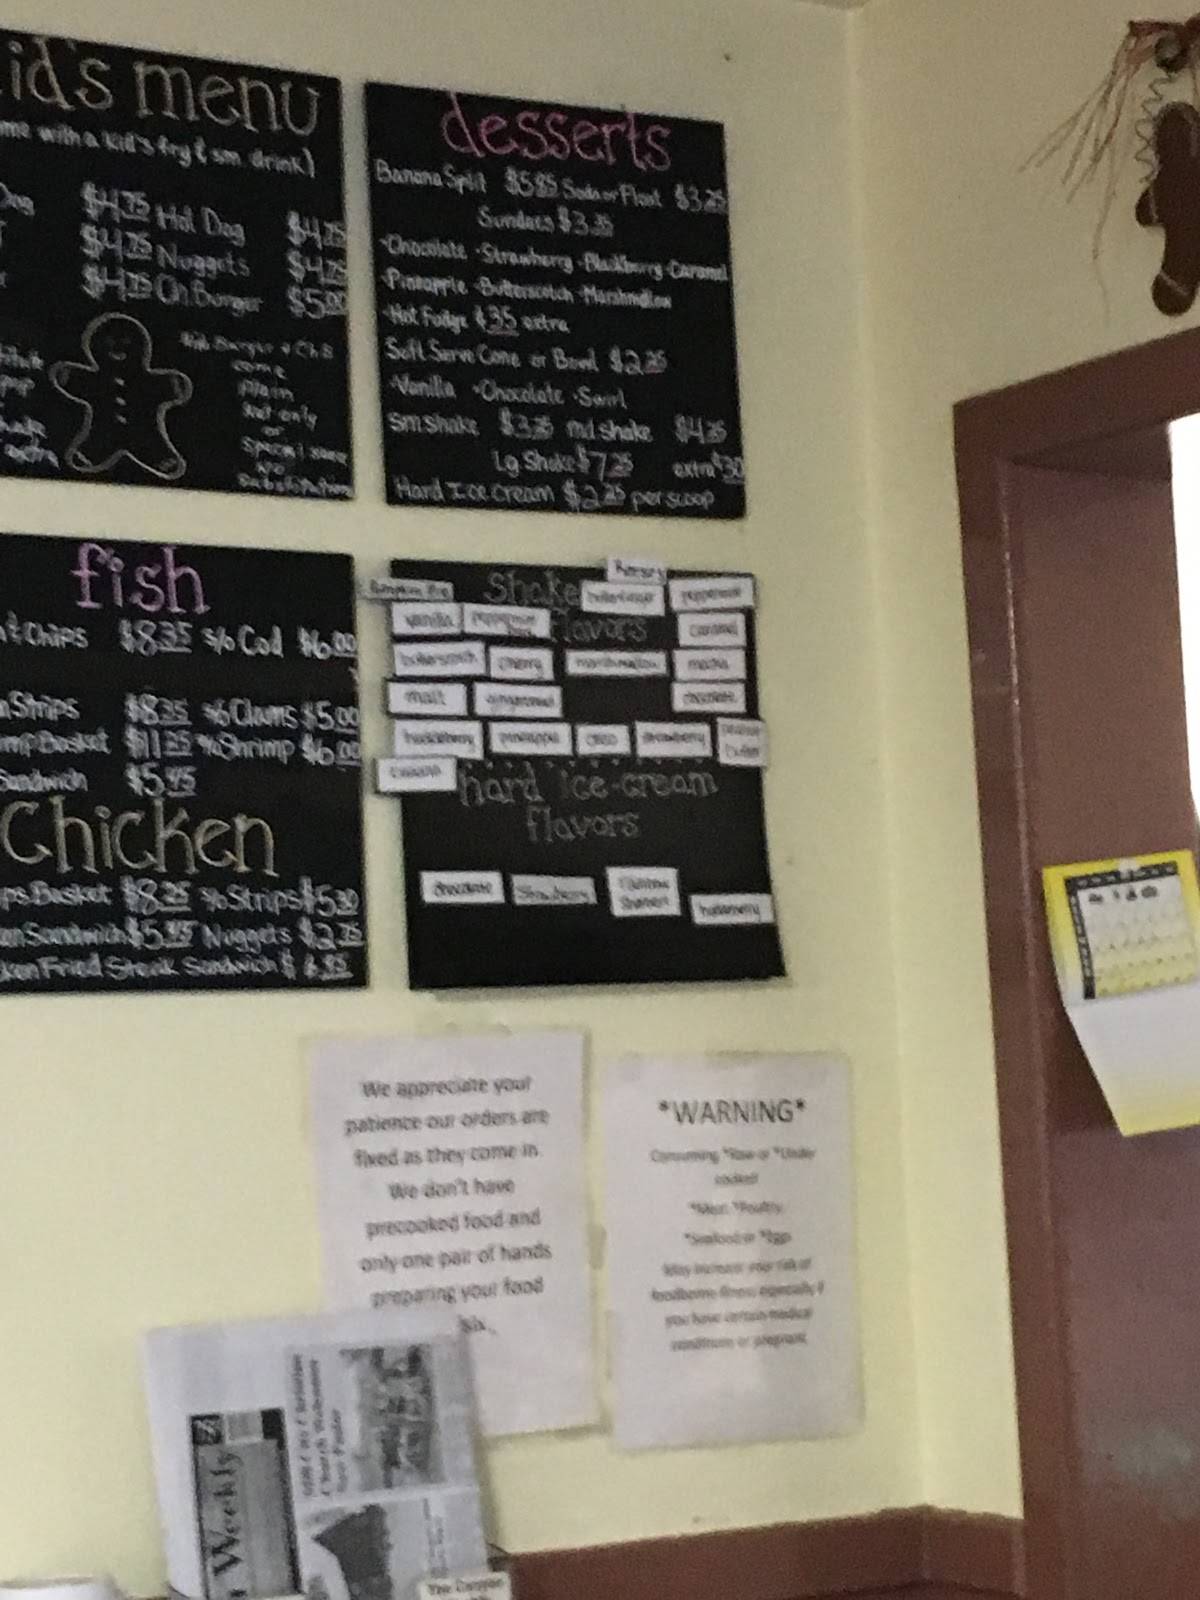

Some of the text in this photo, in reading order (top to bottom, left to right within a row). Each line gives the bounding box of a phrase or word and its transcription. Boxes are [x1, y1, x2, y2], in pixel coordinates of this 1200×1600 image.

[133, 58, 320, 136] menu
[441, 92, 672, 171] desserts
[374, 158, 442, 189] Banana
[444, 160, 487, 196] Split
[202, 206, 246, 247] Dog
[520, 312, 570, 333] extra
[70, 543, 211, 616] fish
[238, 624, 284, 658] Cod
[2, 795, 279, 877] Chicken
[361, 1076, 531, 1099] We appreciate your
[345, 1108, 550, 1136] patience our orders are
[404, 1150, 422, 1165] as
[427, 1147, 464, 1167] they
[470, 1145, 516, 1161] come
[389, 1177, 515, 1200] We don't have
[366, 1207, 541, 1240] precooked food and
[359, 1243, 552, 1274] only one pair of hands
[370, 1276, 543, 1309] preparing your food
